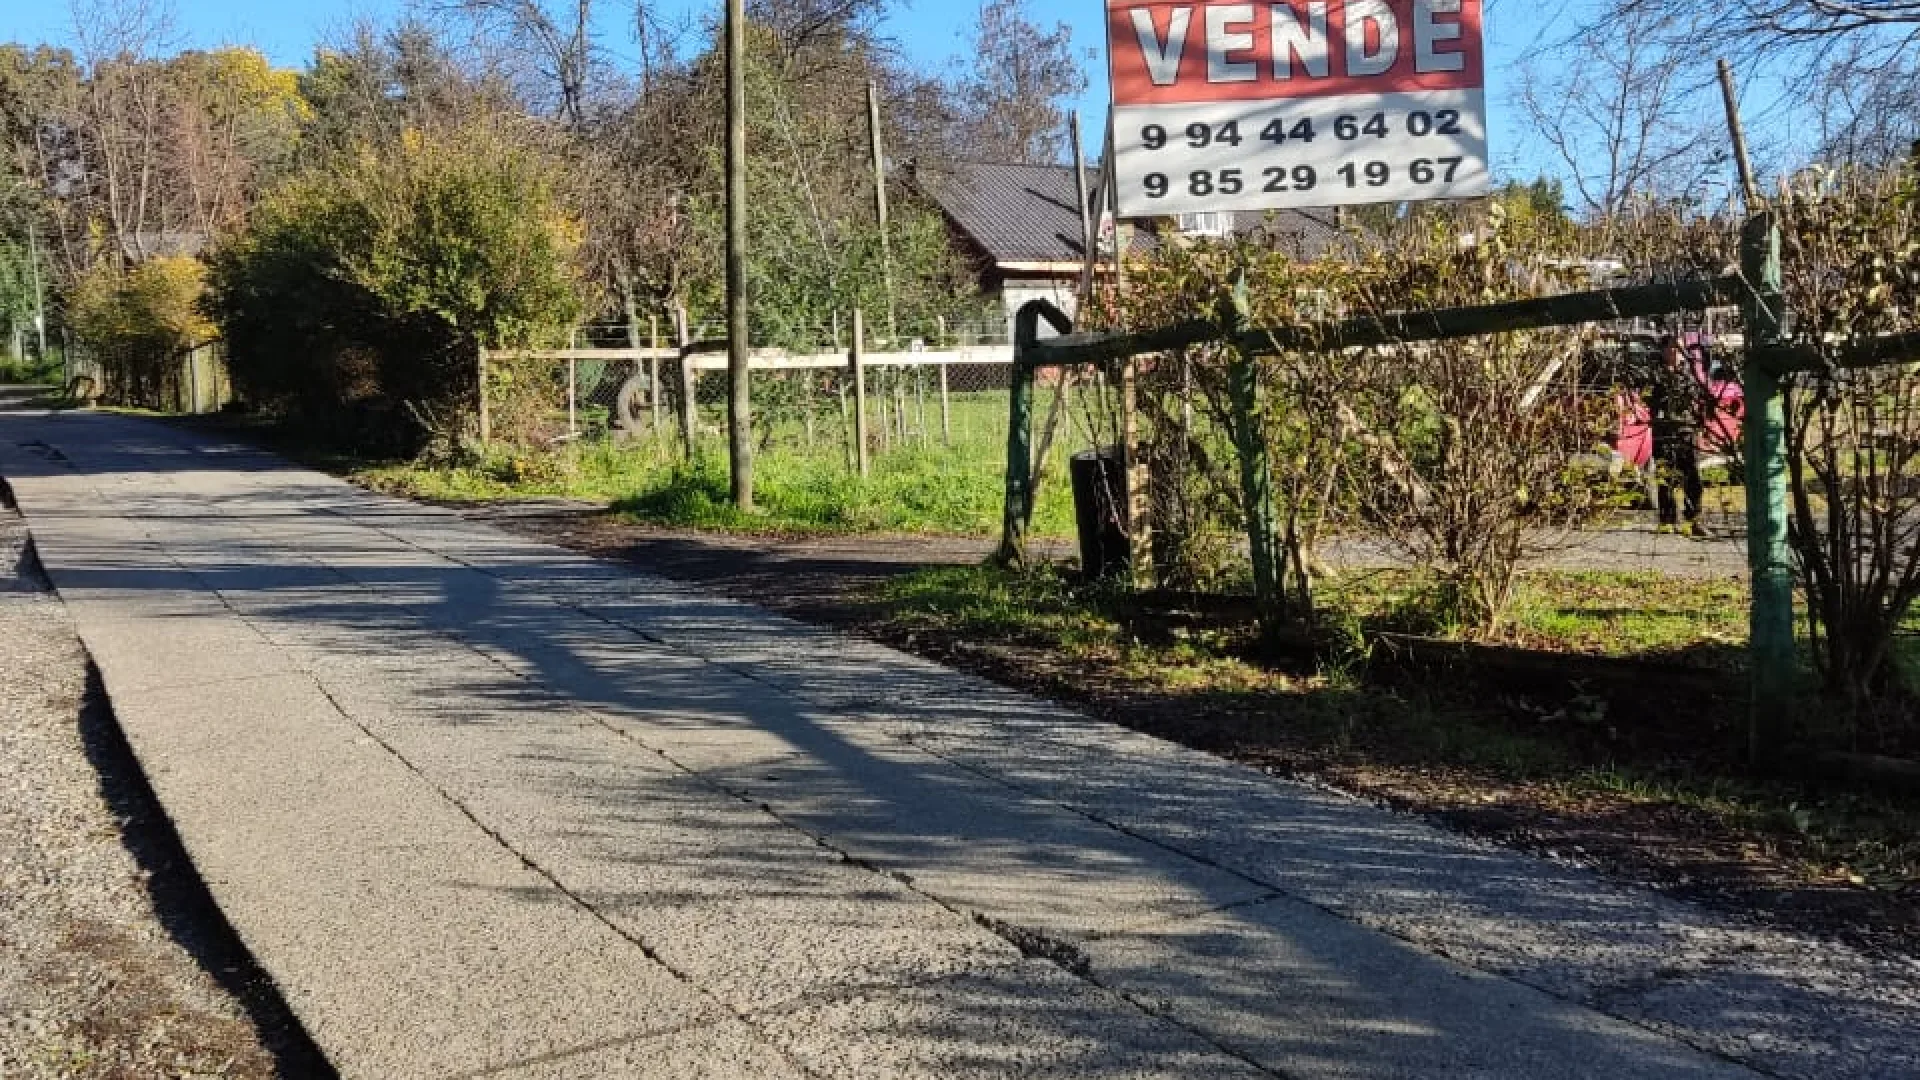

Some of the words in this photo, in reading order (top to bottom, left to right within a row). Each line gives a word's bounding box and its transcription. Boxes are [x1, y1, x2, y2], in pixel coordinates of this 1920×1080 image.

[1130, 0, 1466, 85] VENDE
[1141, 124, 1167, 150] 9
[1186, 120, 1242, 148] 94
[1260, 117, 1316, 145] 44
[1333, 112, 1389, 141] 64
[1406, 109, 1461, 137] 02
[1142, 172, 1169, 199] 9
[1188, 169, 1243, 197] 85
[1262, 165, 1317, 192] 29
[1337, 161, 1390, 188] 19
[1409, 156, 1463, 185] 67
